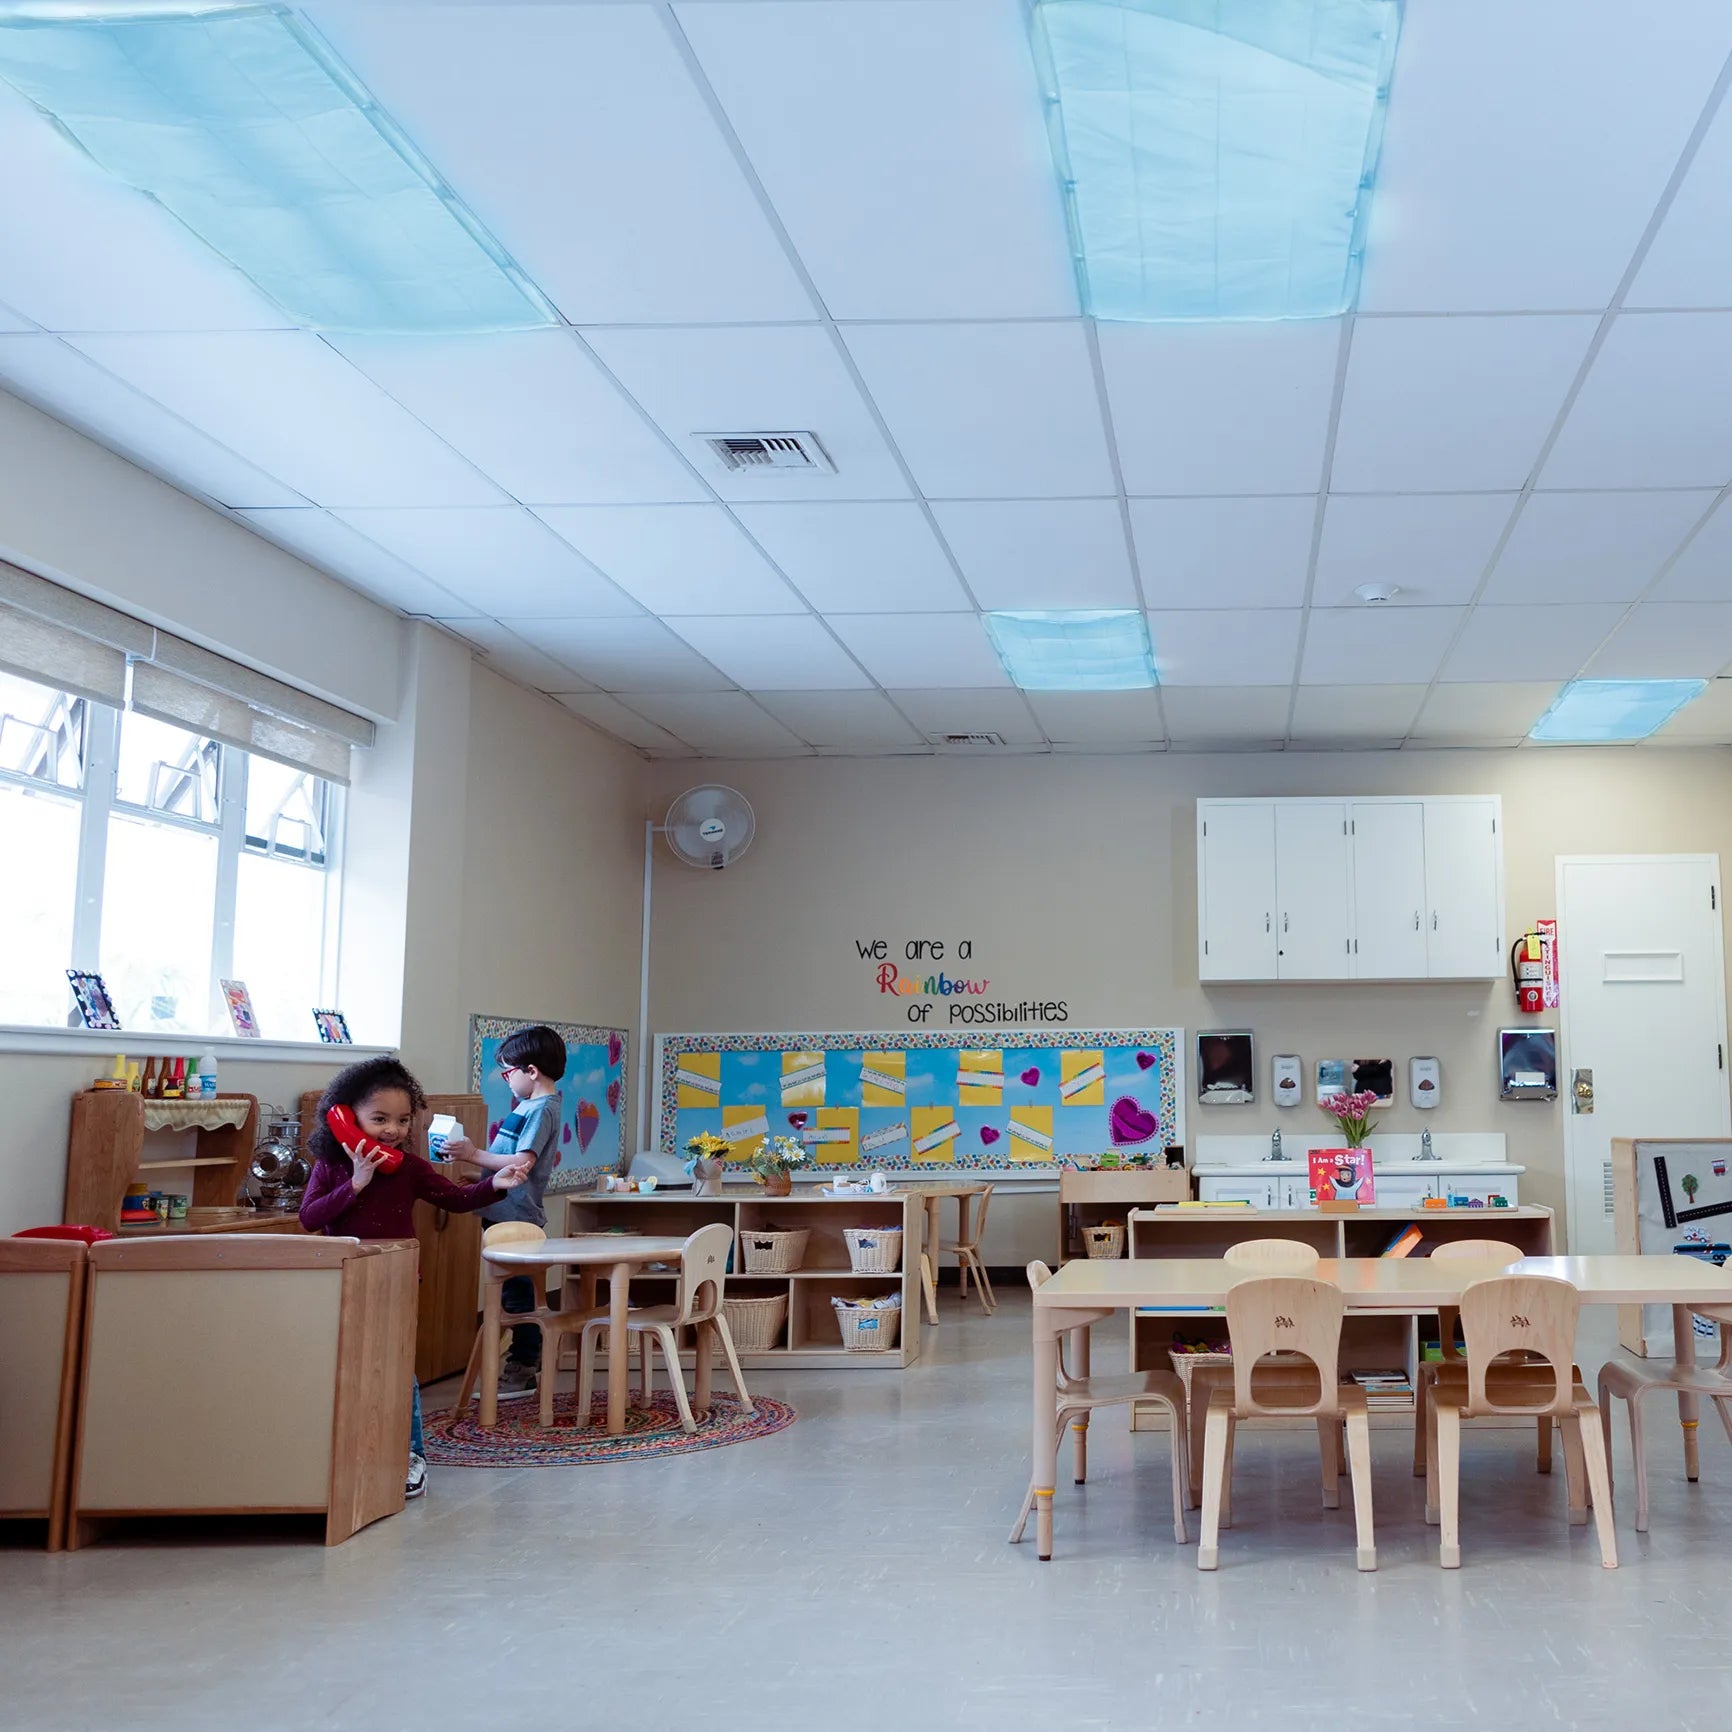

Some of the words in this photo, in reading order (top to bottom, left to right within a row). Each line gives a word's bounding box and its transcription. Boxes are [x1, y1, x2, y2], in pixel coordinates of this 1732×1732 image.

[1539, 927, 1554, 935] FIRE
[905, 940, 944, 960] are
[958, 940, 972, 960] a
[876, 962, 990, 997] Rainbow
[907, 1003, 933, 1023] of
[949, 1000, 1069, 1024] possibilities
[1317, 1156, 1329, 1164] Am
[1334, 1153, 1366, 1166] Star!
